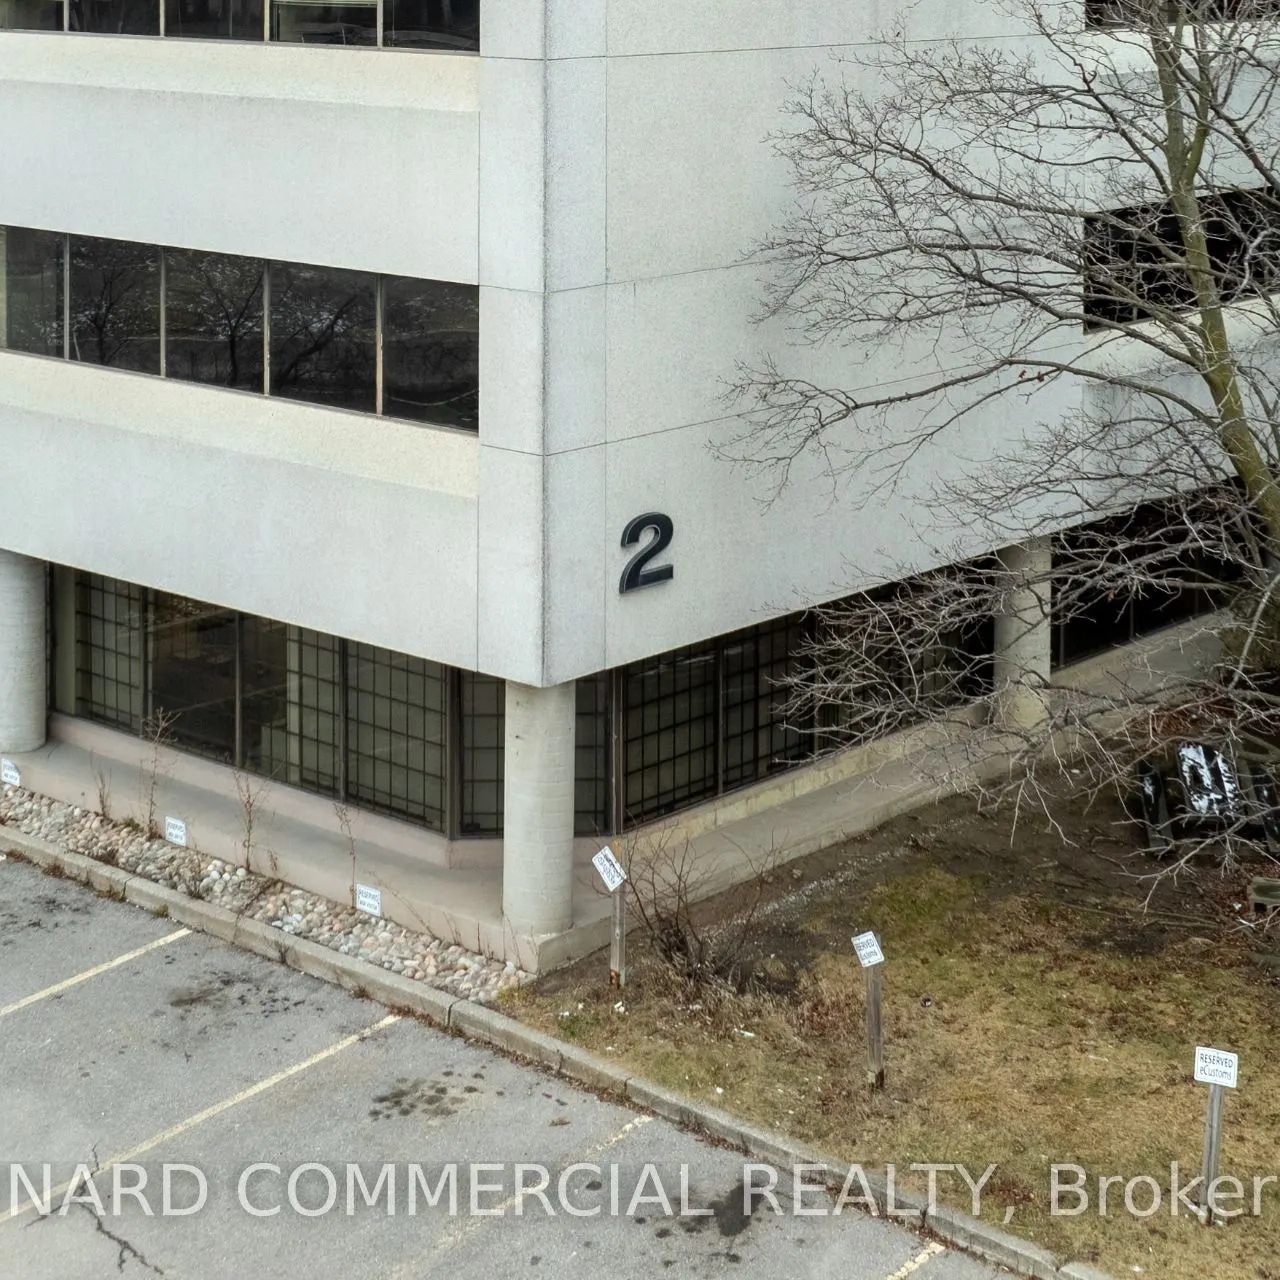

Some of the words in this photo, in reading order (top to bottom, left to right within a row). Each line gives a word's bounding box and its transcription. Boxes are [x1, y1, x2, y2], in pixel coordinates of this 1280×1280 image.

[619, 512, 673, 594] 2
[1200, 1053, 1233, 1069] RESERVED
[1200, 1064, 1232, 1080] eCustoms
